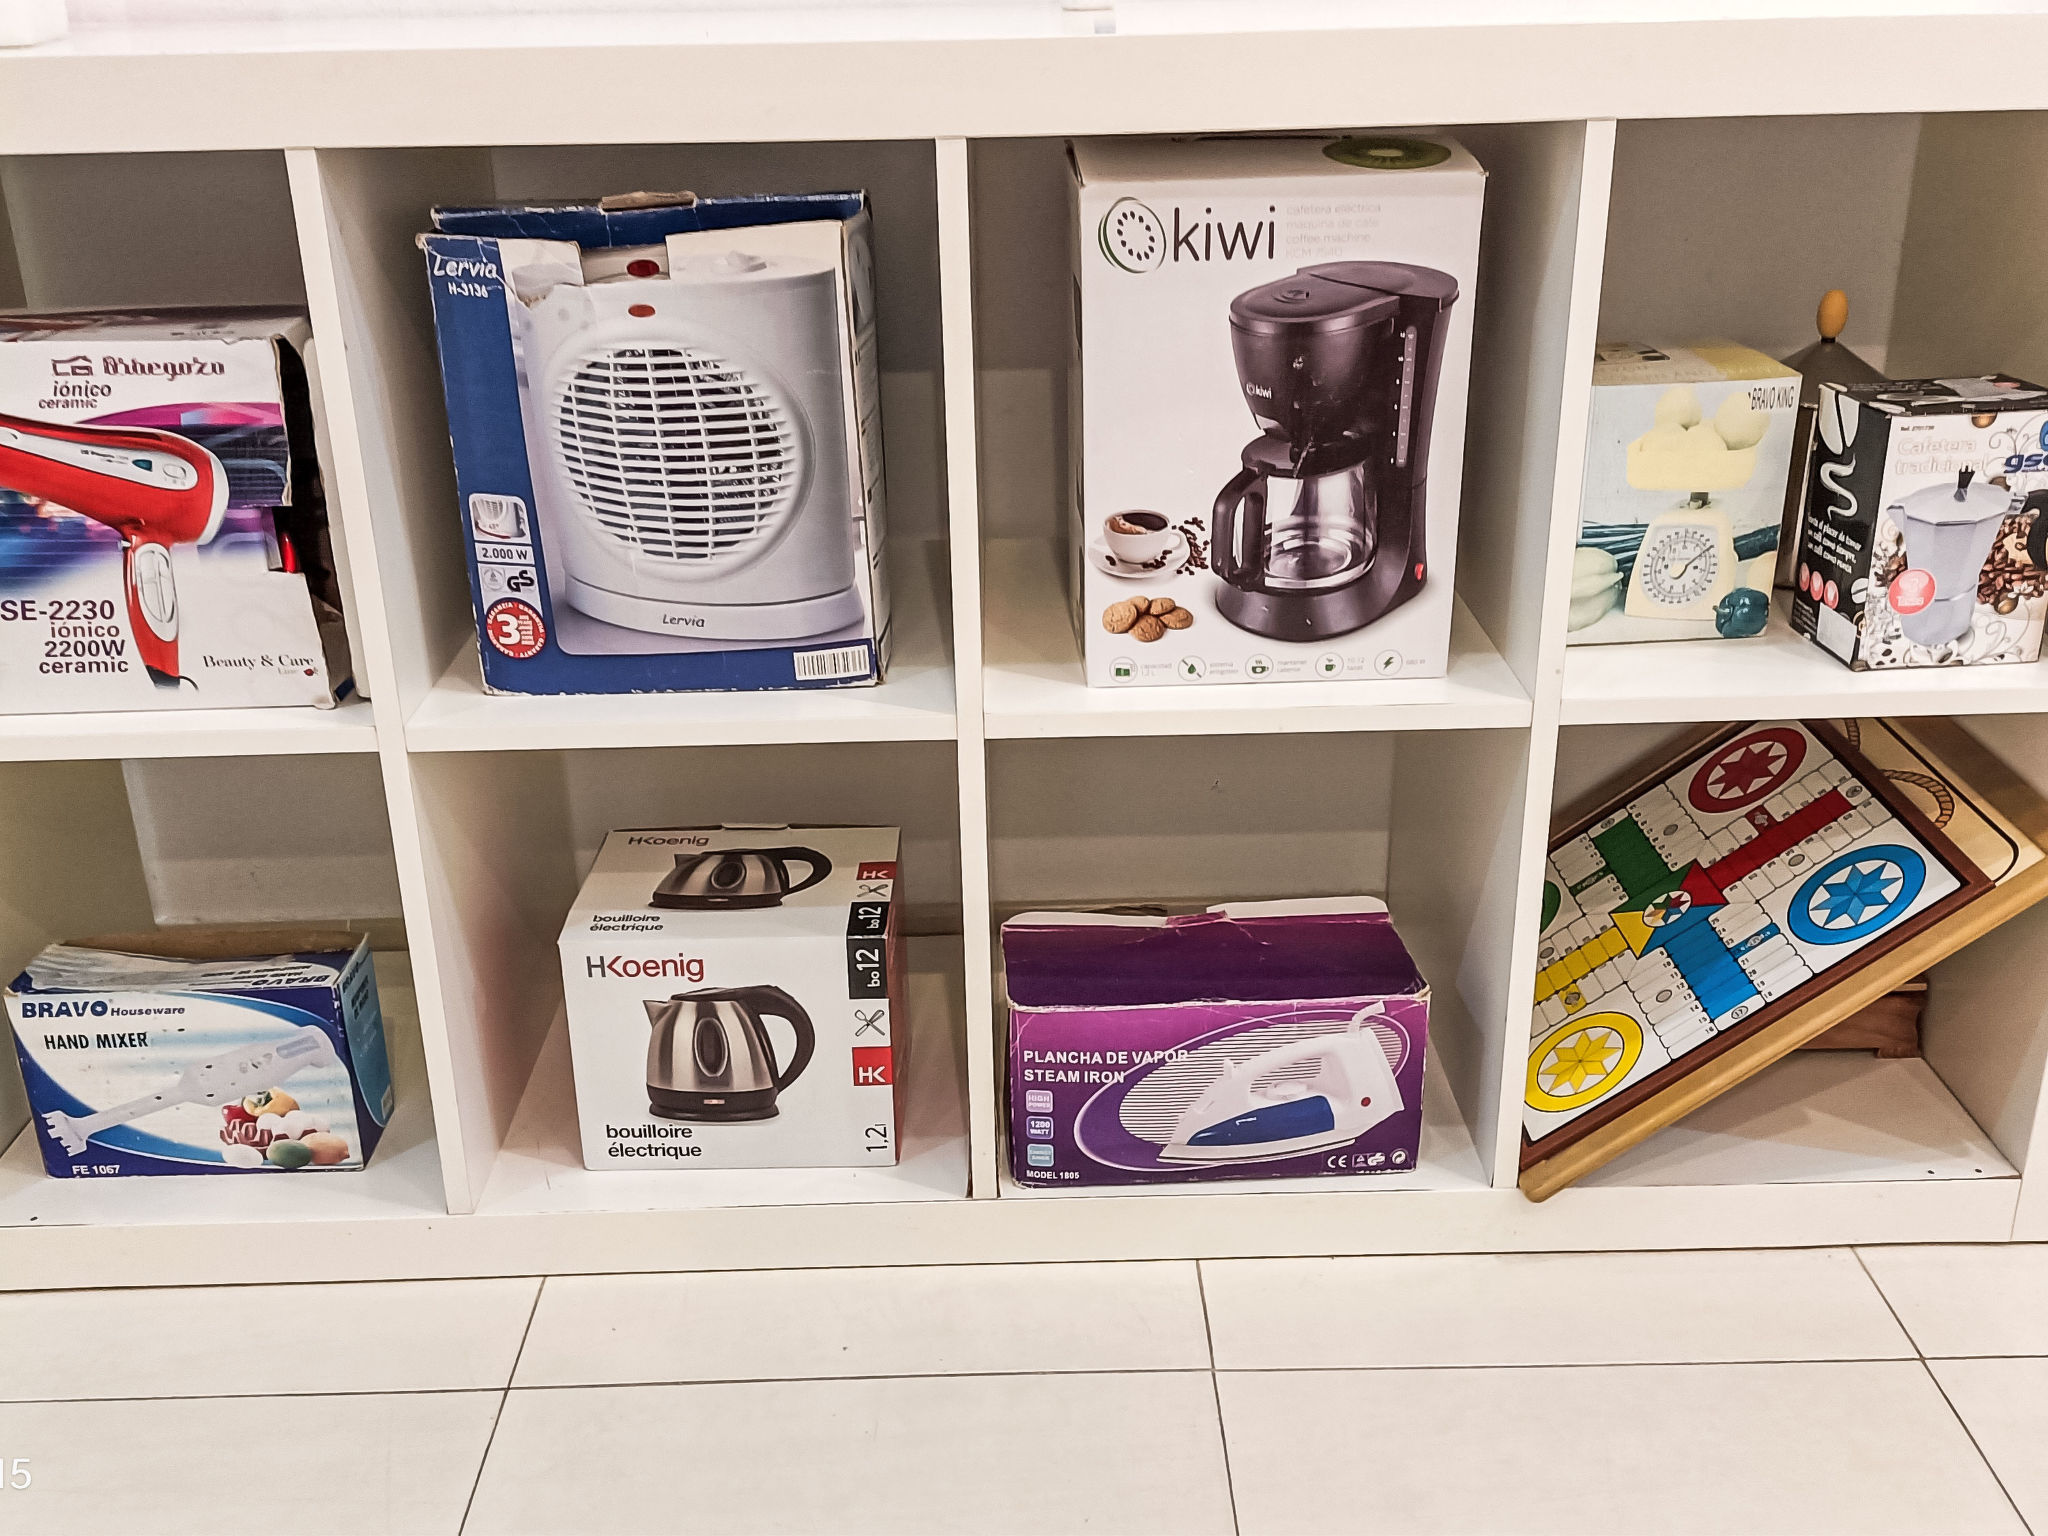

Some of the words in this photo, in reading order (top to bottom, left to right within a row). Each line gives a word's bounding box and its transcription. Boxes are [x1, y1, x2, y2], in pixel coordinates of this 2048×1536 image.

[1173, 204, 1276, 262] kiwi
[433, 254, 498, 279] Lervia
[53, 380, 112, 398] iónico
[38, 397, 98, 410] ceramic
[1751, 387, 1776, 411] BRAVO
[1776, 385, 1795, 409] KING
[1898, 437, 1976, 454] Cafetera
[482, 547, 514, 560] 2.000
[516, 550, 528, 561] W
[0, 599, 115, 621] SE-2230
[496, 613, 521, 645] 3
[662, 613, 705, 628] Lervia
[50, 621, 120, 638] iónico
[44, 639, 126, 658] 2200W
[38, 655, 129, 675] ceramic
[202, 655, 256, 671] Beauty
[260, 655, 274, 667] &
[278, 654, 314, 667] Care
[628, 835, 710, 847] HKoenig
[593, 914, 661, 923] bouilloire
[589, 923, 664, 932] électrique
[586, 952, 704, 983] HKoenig
[22, 1001, 108, 1018] BRAVO
[110, 1007, 185, 1016] Houseware
[44, 1034, 89, 1050] HAND
[96, 1032, 149, 1049] MIXER
[1023, 1050, 1103, 1065] PLANCHA
[1106, 1051, 1128, 1065] DE
[1131, 1049, 1188, 1064] VAPOR
[858, 1065, 886, 1084] HK
[1024, 1069, 1080, 1083] STEAM
[1084, 1070, 1125, 1083] IRON
[606, 1124, 693, 1139] bouilloire
[608, 1141, 702, 1160] électrique
[72, 1164, 90, 1175] FE
[91, 1164, 121, 1175] 1067
[1026, 1169, 1059, 1180] MODEL
[1059, 1171, 1080, 1180] 1805
